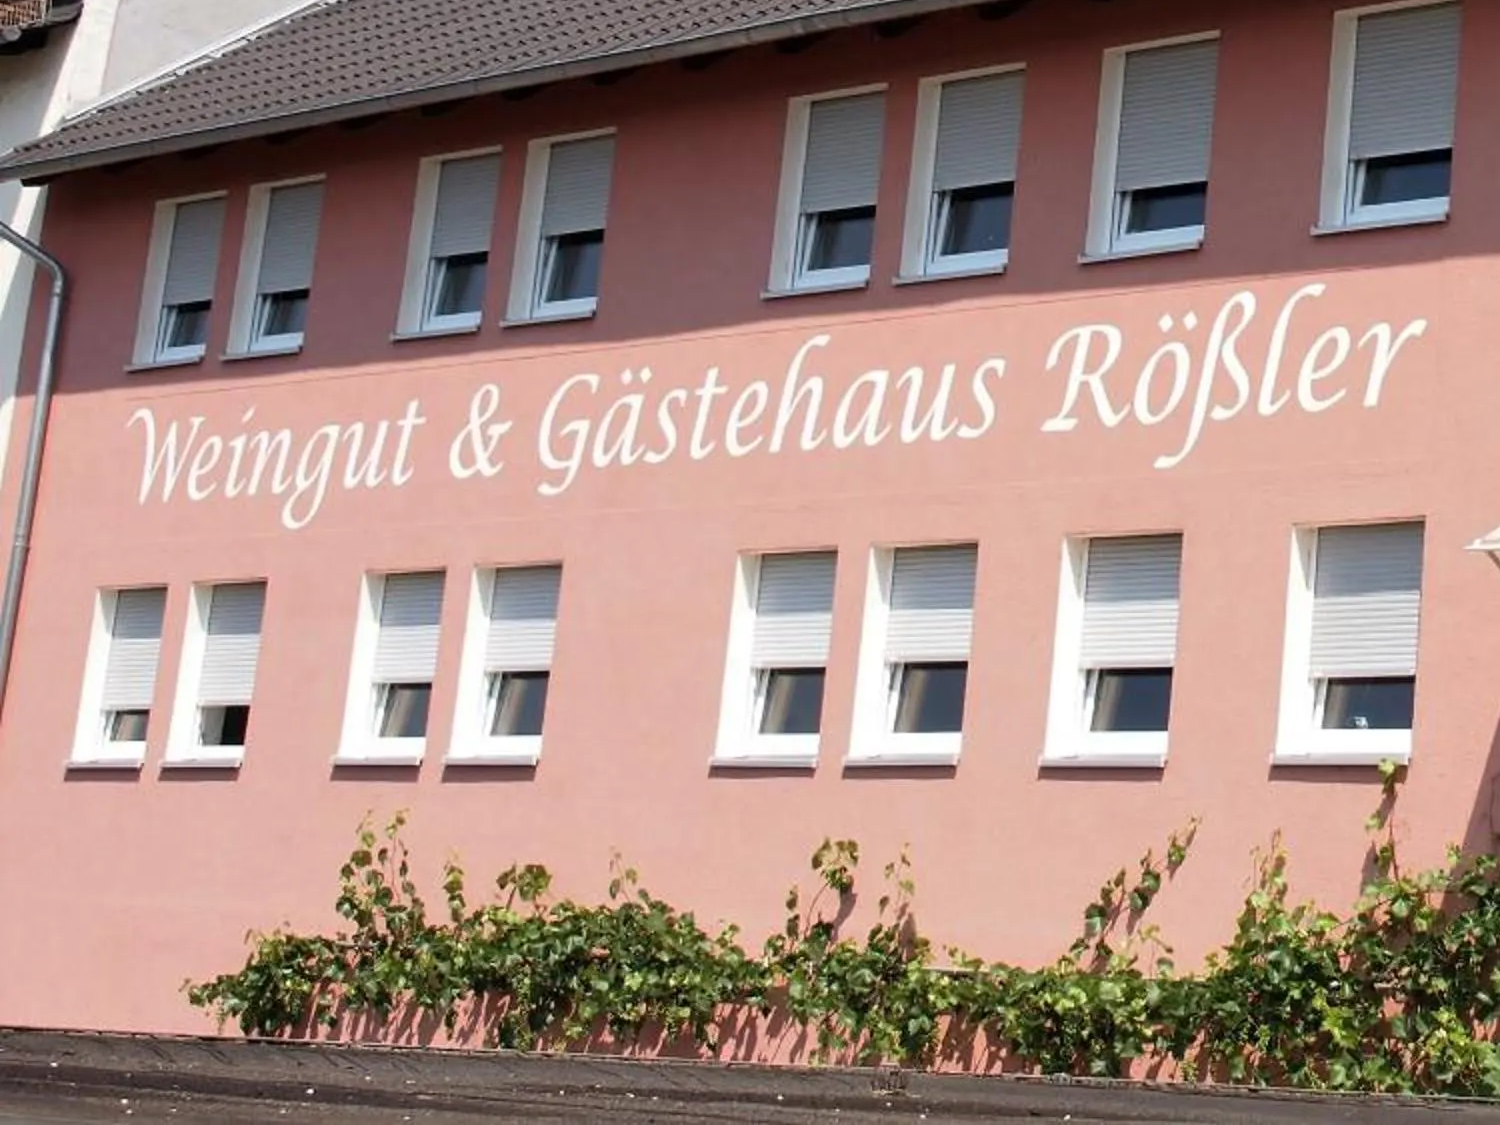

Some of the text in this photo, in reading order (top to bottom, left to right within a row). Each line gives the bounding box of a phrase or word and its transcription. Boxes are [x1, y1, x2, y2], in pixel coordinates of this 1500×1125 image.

[126, 282, 1428, 530] Weingut & Gästehaus Rößler
